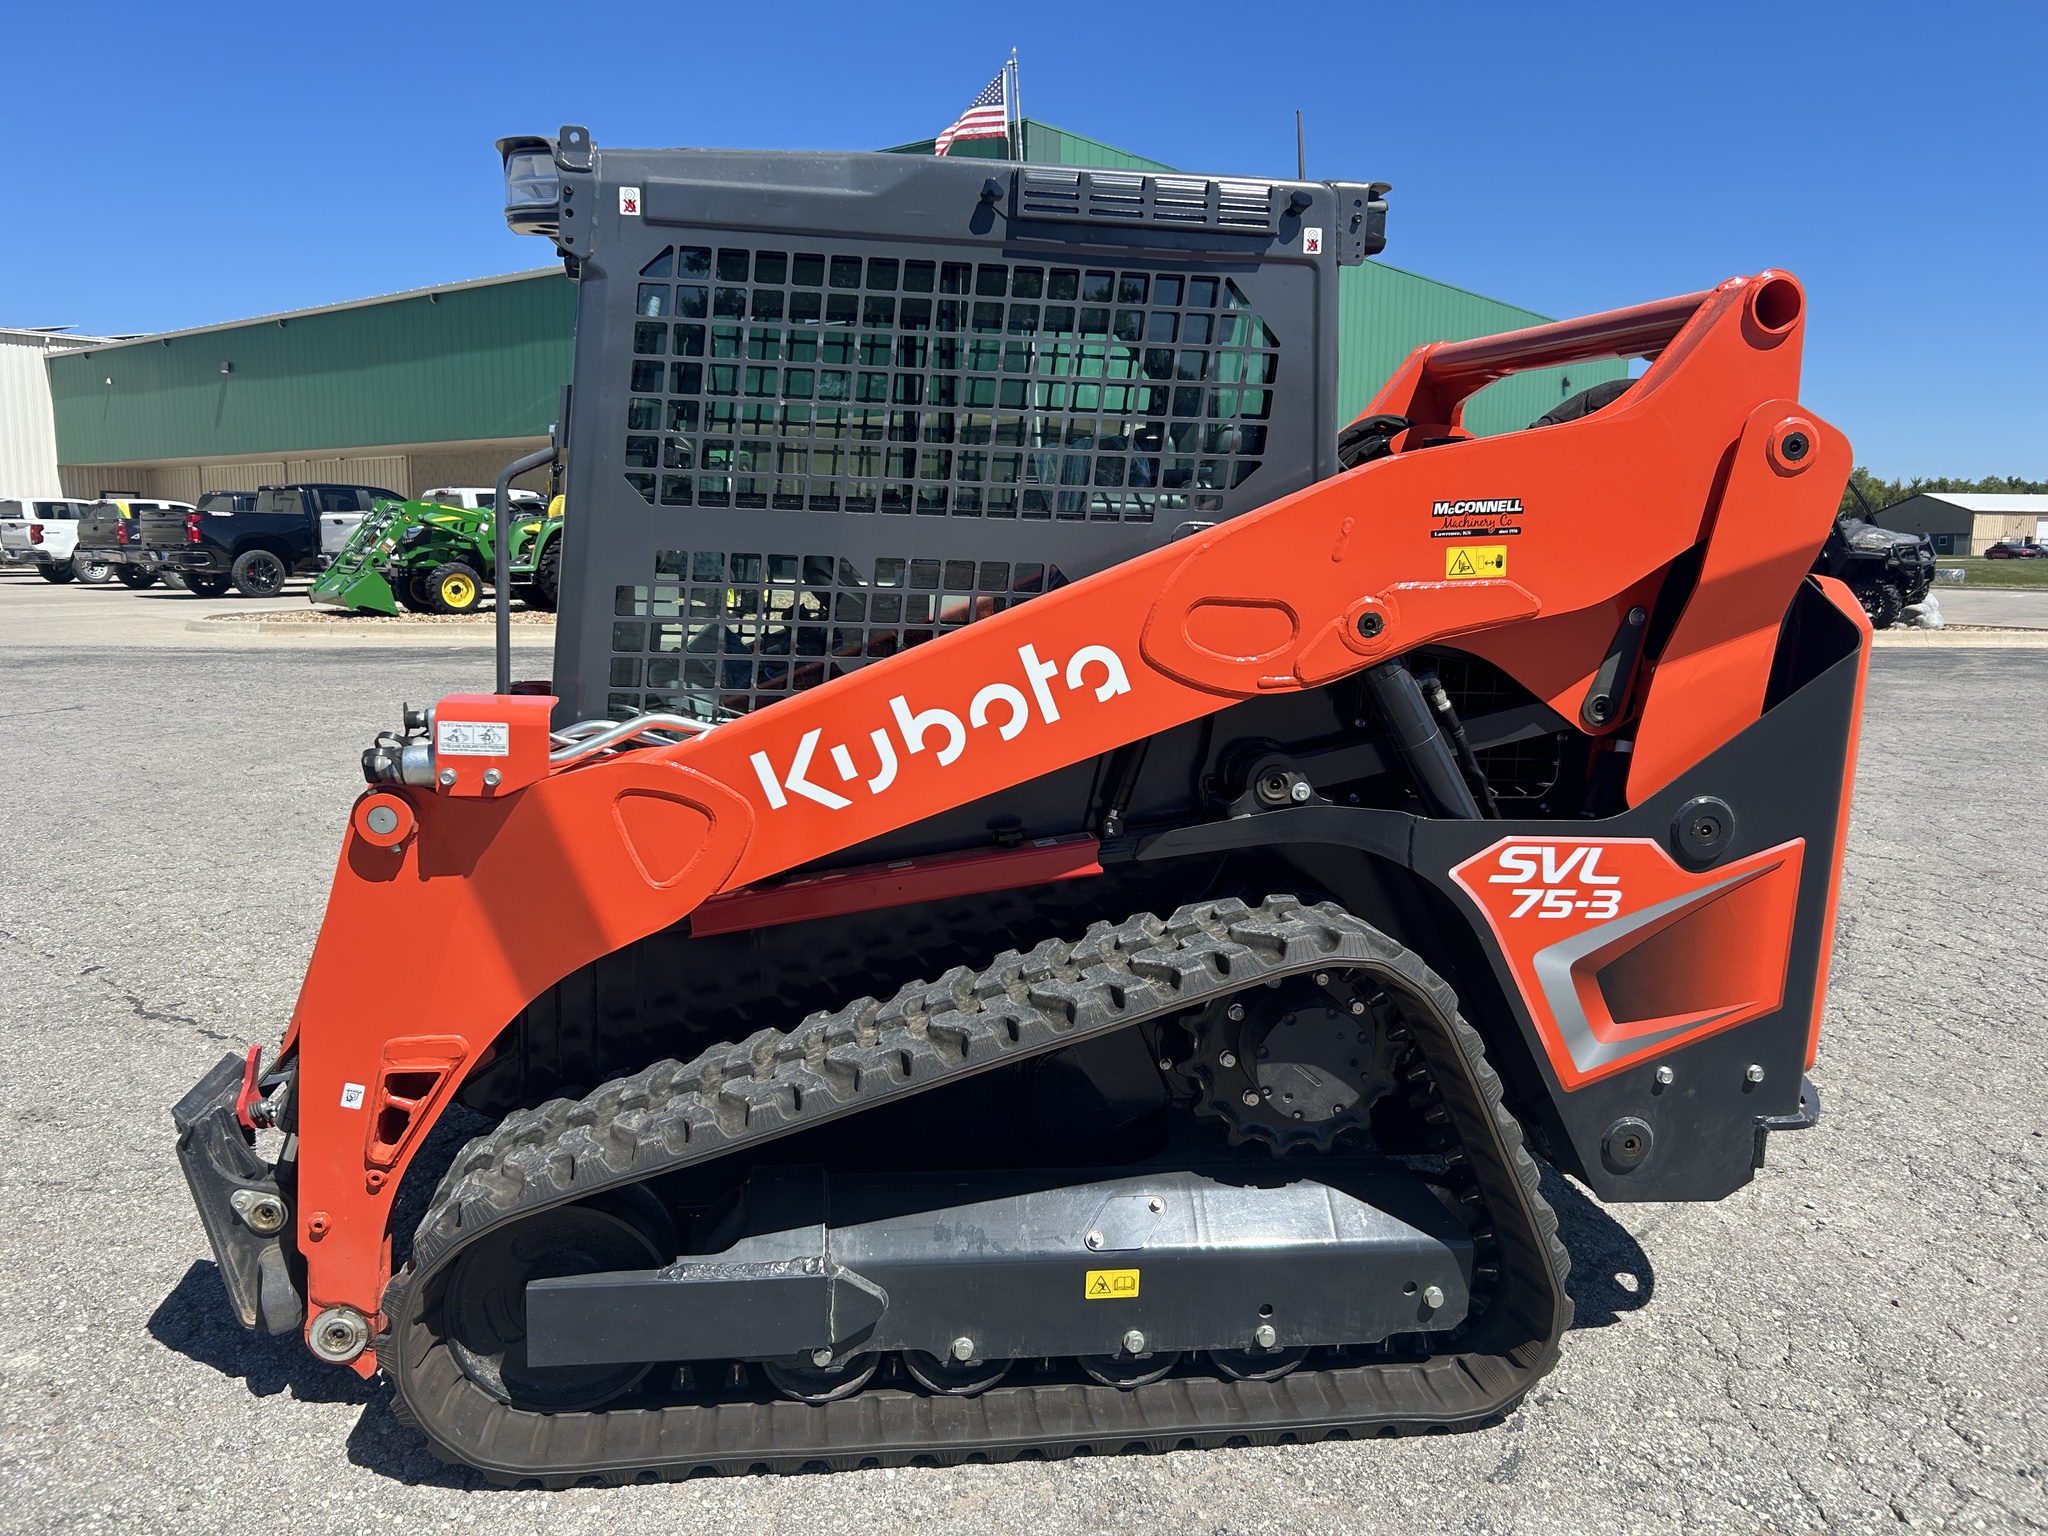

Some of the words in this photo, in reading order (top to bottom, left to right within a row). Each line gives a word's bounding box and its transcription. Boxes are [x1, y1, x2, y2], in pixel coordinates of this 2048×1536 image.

[1433, 500, 1522, 515] McCONNELL
[1441, 512, 1496, 532] Machinery
[1499, 513, 1512, 526] Co
[749, 643, 1132, 810] Kubota
[1488, 846, 1621, 885] SVL
[1508, 889, 1622, 919] 75-3
